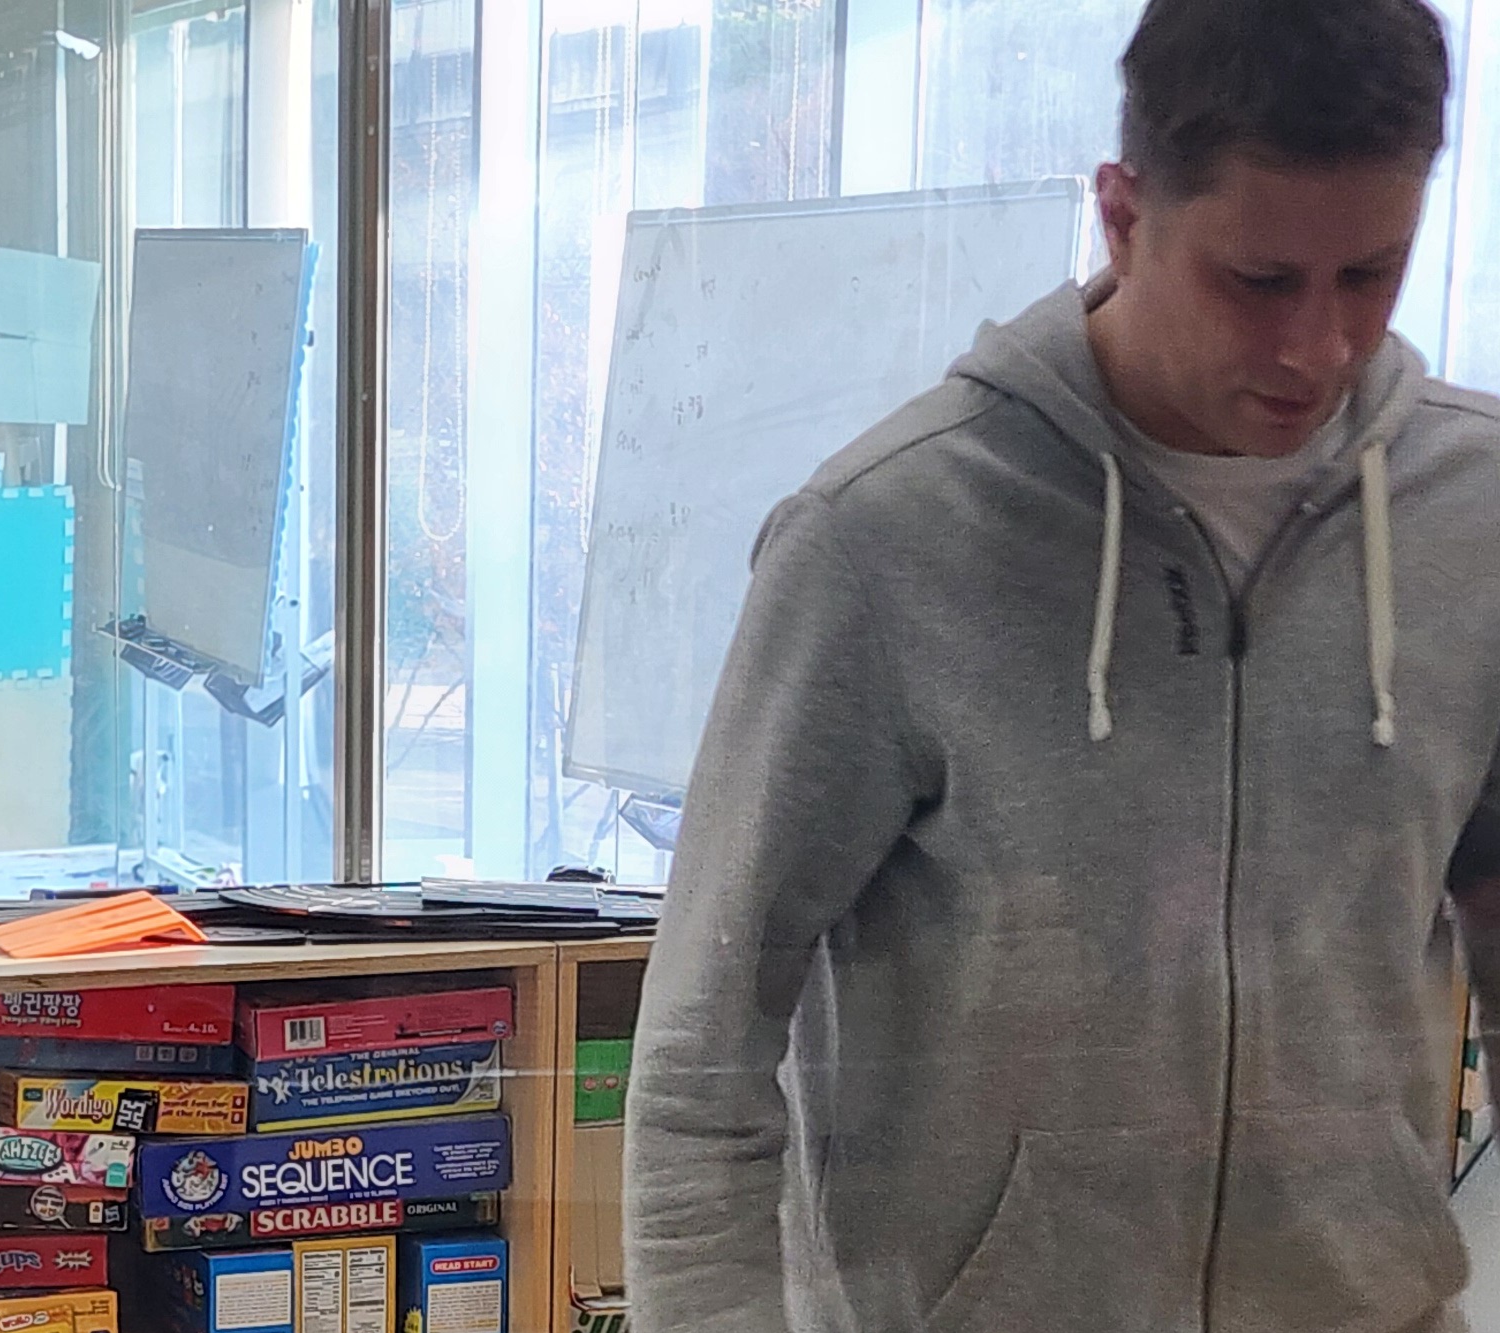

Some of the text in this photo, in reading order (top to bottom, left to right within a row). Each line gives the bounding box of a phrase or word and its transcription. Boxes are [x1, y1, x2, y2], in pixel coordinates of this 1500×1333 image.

[295, 1059, 463, 1094] Telestrations
[46, 1088, 113, 1120] Wordigo
[288, 1137, 364, 1160] JUMBO
[241, 1153, 413, 1200] SEQUENCE
[257, 1202, 457, 1232] SCRABBLE ORIGINAL
